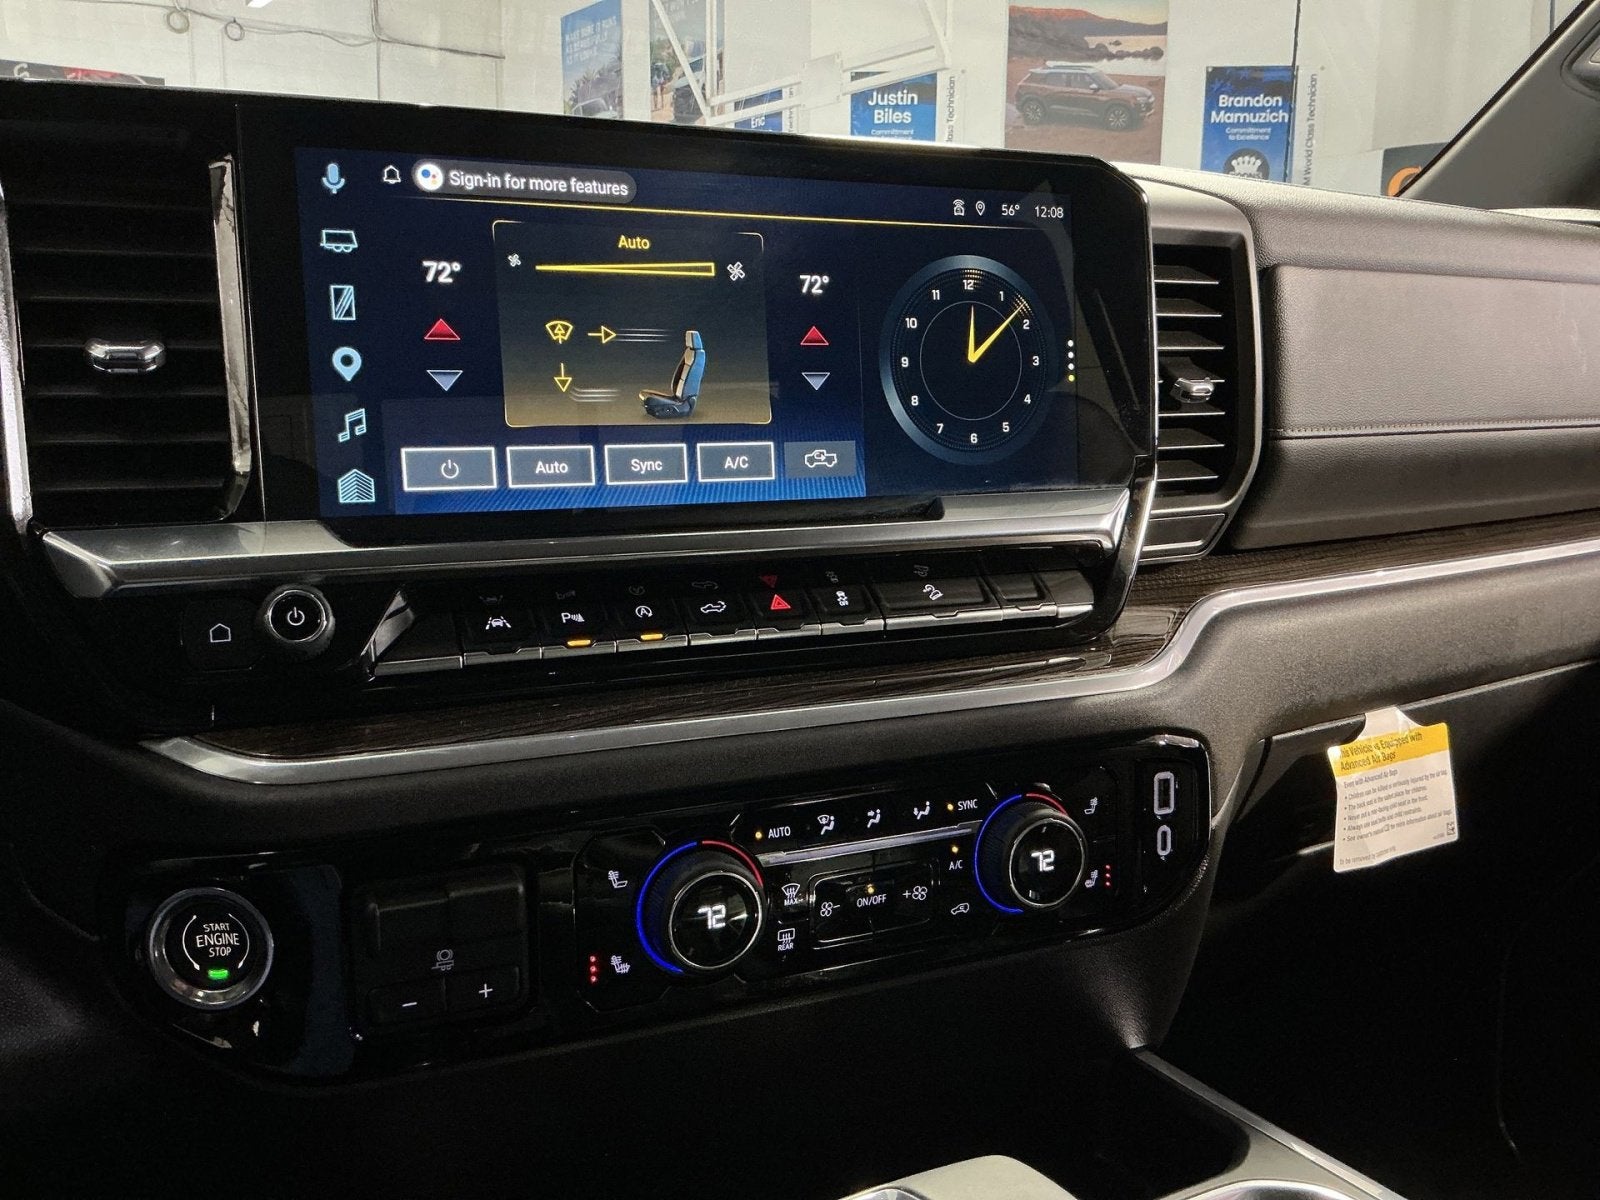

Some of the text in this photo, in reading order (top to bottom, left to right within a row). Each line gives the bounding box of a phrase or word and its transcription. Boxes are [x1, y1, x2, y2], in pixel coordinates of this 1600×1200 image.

[868, 89, 918, 106] Justin
[946, 76, 955, 123] Technician
[1218, 94, 1283, 108] Brandon
[1306, 74, 1318, 121] Technician
[874, 109, 912, 124] Biles
[1210, 109, 1289, 124] Mamuzich
[1305, 123, 1315, 148] Class
[1304, 149, 1313, 174] World
[450, 171, 629, 196] Sign-in for more features
[1001, 204, 1020, 216] 56°
[1034, 206, 1064, 219] 12:08
[618, 235, 650, 250] Auto
[421, 259, 462, 283] 72°
[799, 273, 830, 294] 72°
[962, 279, 975, 290] 12
[931, 290, 941, 300] 11
[905, 317, 918, 329] 10
[1022, 319, 1030, 330] 2
[901, 356, 909, 368] 9
[1032, 355, 1040, 367] 3
[910, 395, 919, 406] 8
[1023, 394, 1032, 405] 4
[936, 423, 944, 435] 7
[1002, 422, 1010, 433] 5
[970, 433, 978, 444] 6
[535, 460, 569, 475] Auto
[630, 458, 663, 475] Sync
[724, 456, 749, 470] A/C
[1349, 744, 1373, 756] Vehicle
[1379, 735, 1409, 750] Equipped
[1410, 731, 1423, 742] with
[1340, 756, 1371, 771] Advanced
[1381, 751, 1396, 763] Bags
[957, 799, 978, 811] SYNC
[768, 826, 791, 839] AUTO
[949, 859, 963, 871] A/C
[1031, 850, 1055, 872] 72
[856, 894, 887, 908] ON/OFF
[697, 904, 726, 930] 72
[203, 922, 230, 932] START
[195, 932, 240, 948] ENGINE
[777, 942, 794, 951] REAR
[208, 946, 232, 957] STOP
